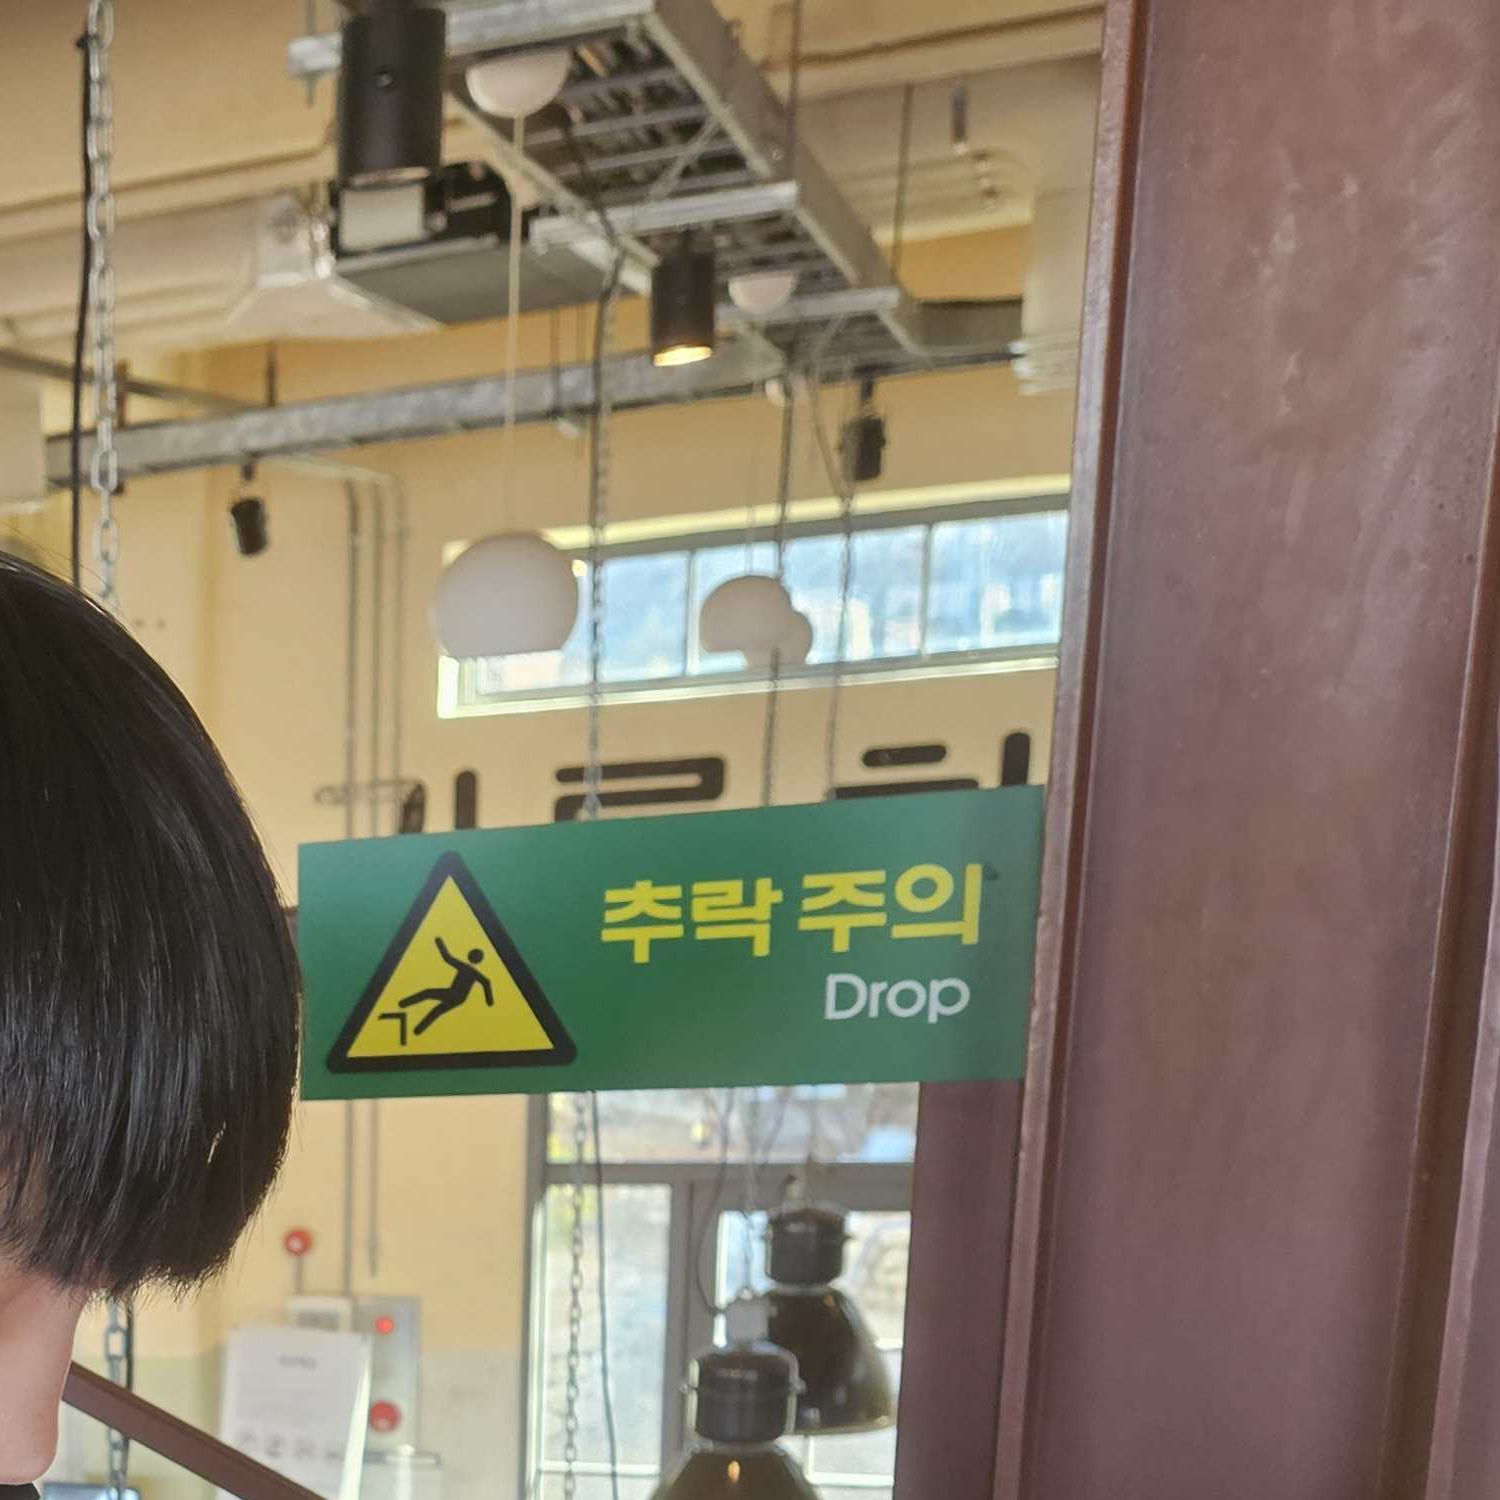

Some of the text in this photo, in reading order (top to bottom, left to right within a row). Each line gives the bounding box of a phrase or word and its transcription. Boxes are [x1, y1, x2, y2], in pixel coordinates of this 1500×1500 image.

[601, 863, 984, 964] 추락 주의
[824, 972, 971, 1024] Drop
